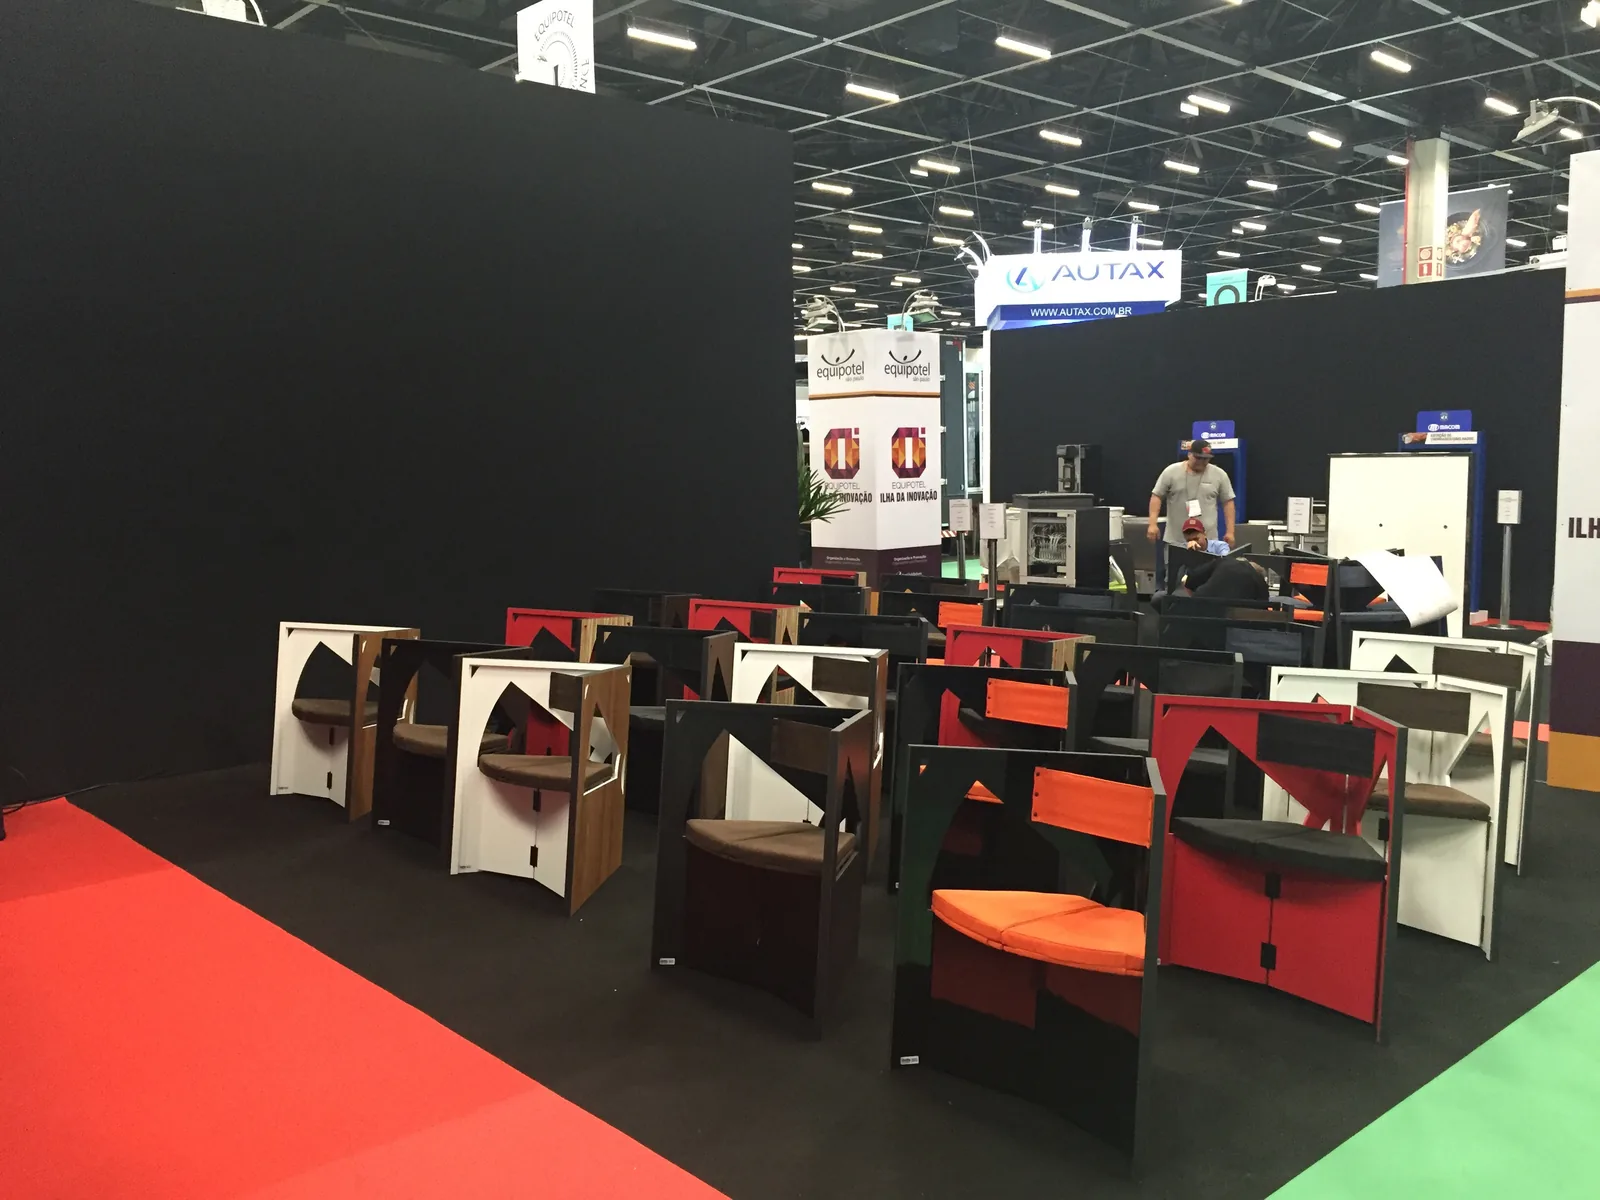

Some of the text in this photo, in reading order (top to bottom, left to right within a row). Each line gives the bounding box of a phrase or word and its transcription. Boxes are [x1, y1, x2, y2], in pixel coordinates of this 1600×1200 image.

[534, 10, 575, 42] EQUIPOTEL
[1051, 260, 1165, 281] AUTAX
[1030, 306, 1133, 318] WWW.AUTAX.COM.BR
[816, 361, 865, 381] equipotel
[884, 362, 931, 379] equipotel
[891, 480, 926, 490] EQUIPOTEL
[880, 489, 938, 503] ILHA DA INOVAÇÃO
